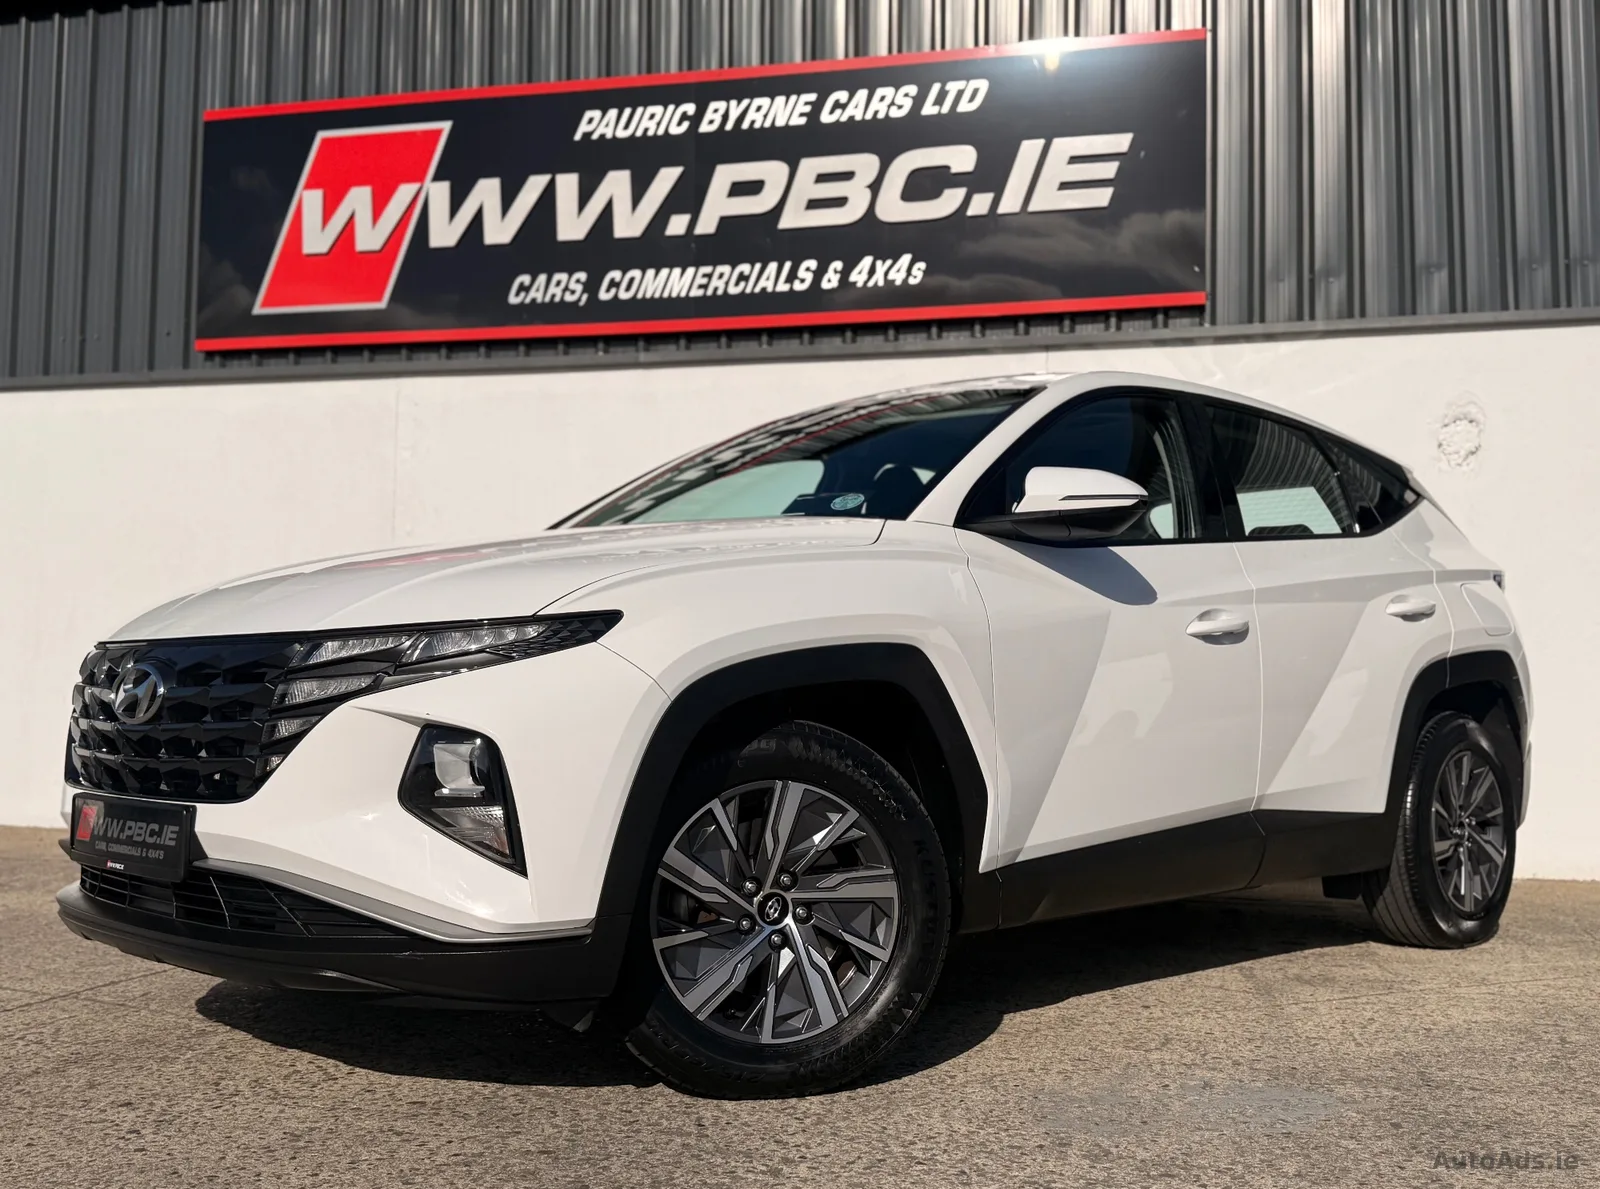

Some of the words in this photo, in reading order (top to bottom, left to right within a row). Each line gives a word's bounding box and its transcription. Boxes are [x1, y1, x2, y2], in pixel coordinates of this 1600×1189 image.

[573, 102, 695, 141] PAURIC
[698, 92, 817, 133] BYRNE
[819, 83, 918, 123] CARS
[920, 78, 989, 115] LTD
[301, 132, 1134, 256] WWW.PBC.IE
[507, 271, 590, 306] CARS,
[598, 258, 817, 302] COMMERCIALS
[820, 258, 843, 289] &
